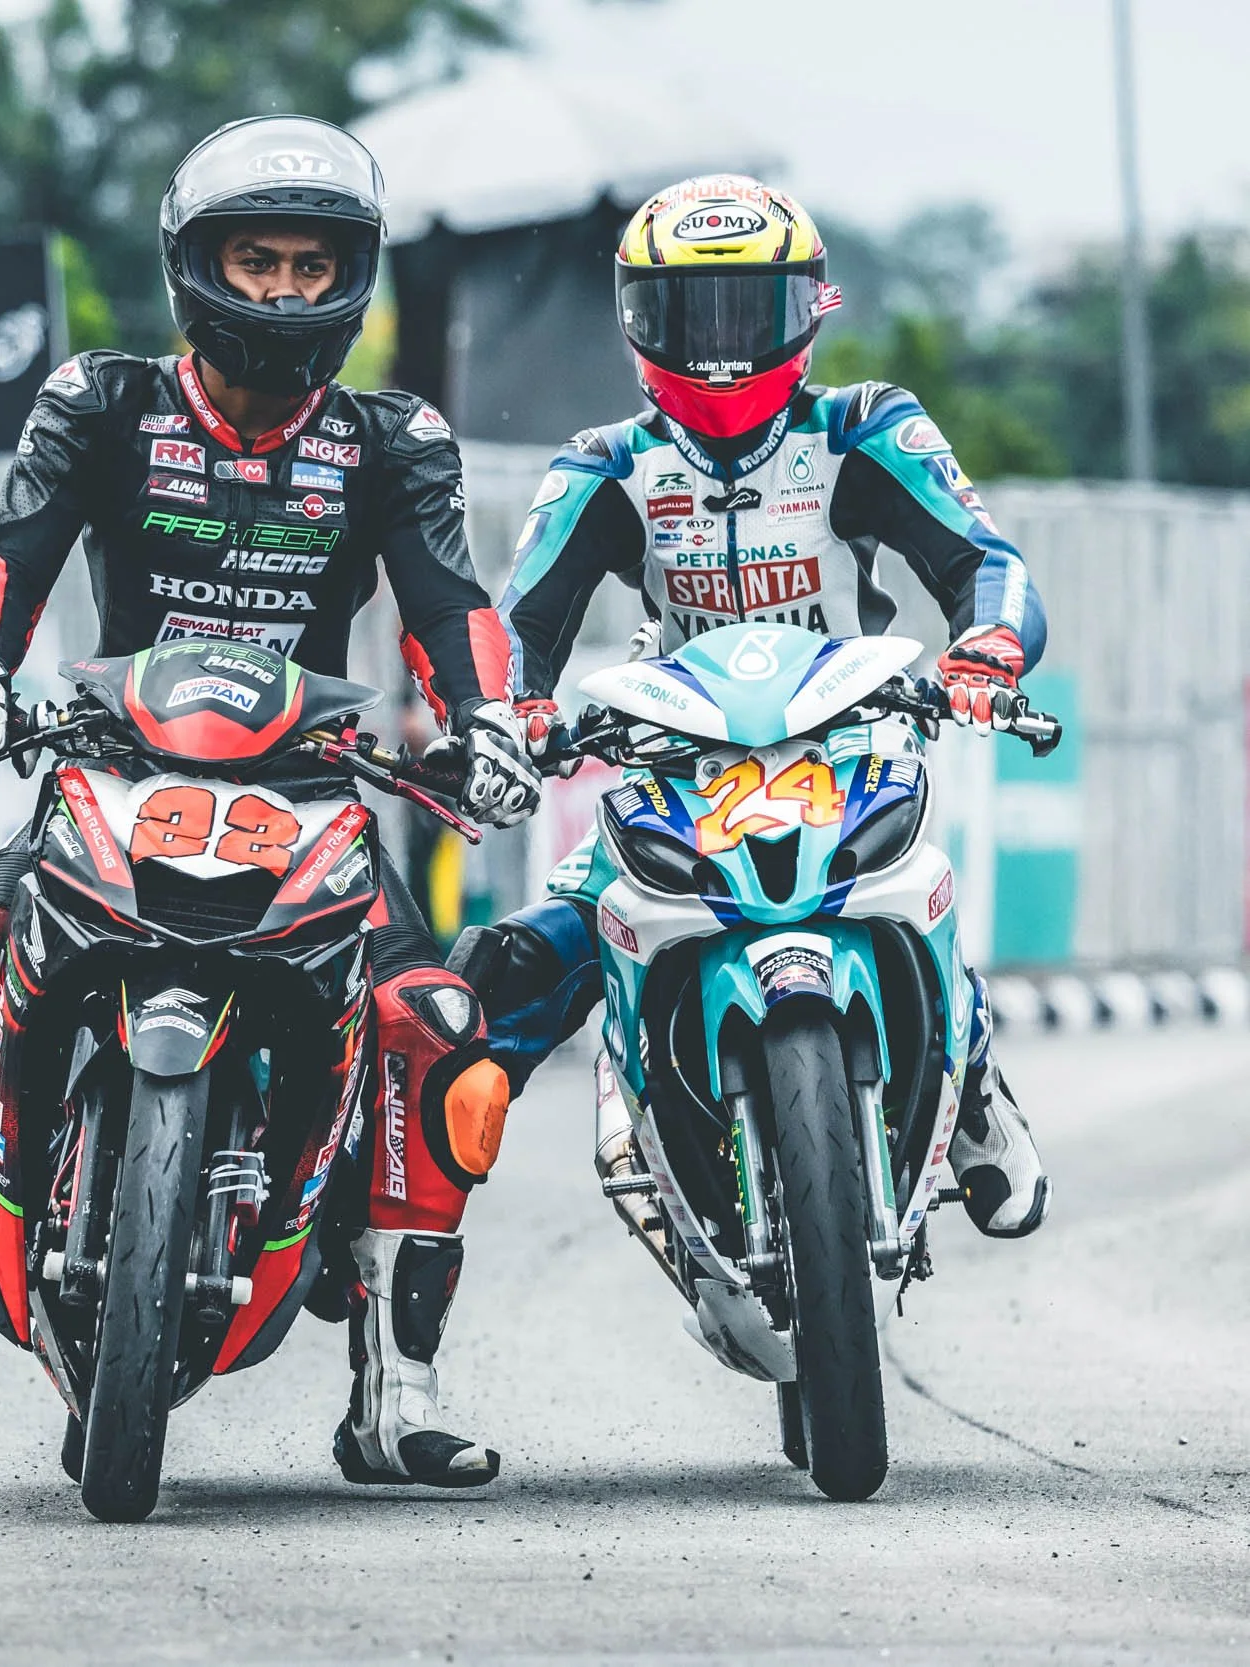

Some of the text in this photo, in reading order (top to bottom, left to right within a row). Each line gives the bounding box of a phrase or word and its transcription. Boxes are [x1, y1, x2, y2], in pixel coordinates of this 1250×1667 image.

[681, 215, 759, 232] SUOMY
[141, 421, 172, 432] racing
[142, 414, 167, 424] uma
[155, 442, 203, 465] RK
[300, 440, 352, 465] NGK
[166, 479, 206, 496] AHM
[780, 482, 825, 496] PETRONAS
[287, 502, 340, 512] KOYOKO
[779, 499, 821, 514] YAMAHA
[676, 543, 798, 568] PETRONAS
[150, 573, 316, 611] HONDA
[672, 564, 812, 610] SPRINTA
[168, 616, 265, 638] SEMANGAT
[815, 649, 880, 700] PETRONAS
[171, 684, 253, 709] IMPIAN
[619, 675, 689, 712] PETRONAS
[687, 756, 846, 857] 24
[69, 779, 117, 869] Honda RACING
[295, 812, 361, 889] Honda RACING
[760, 950, 828, 973] PETRONAS
[760, 957, 831, 981] PRIMAX
[141, 999, 207, 1024] HONDA
